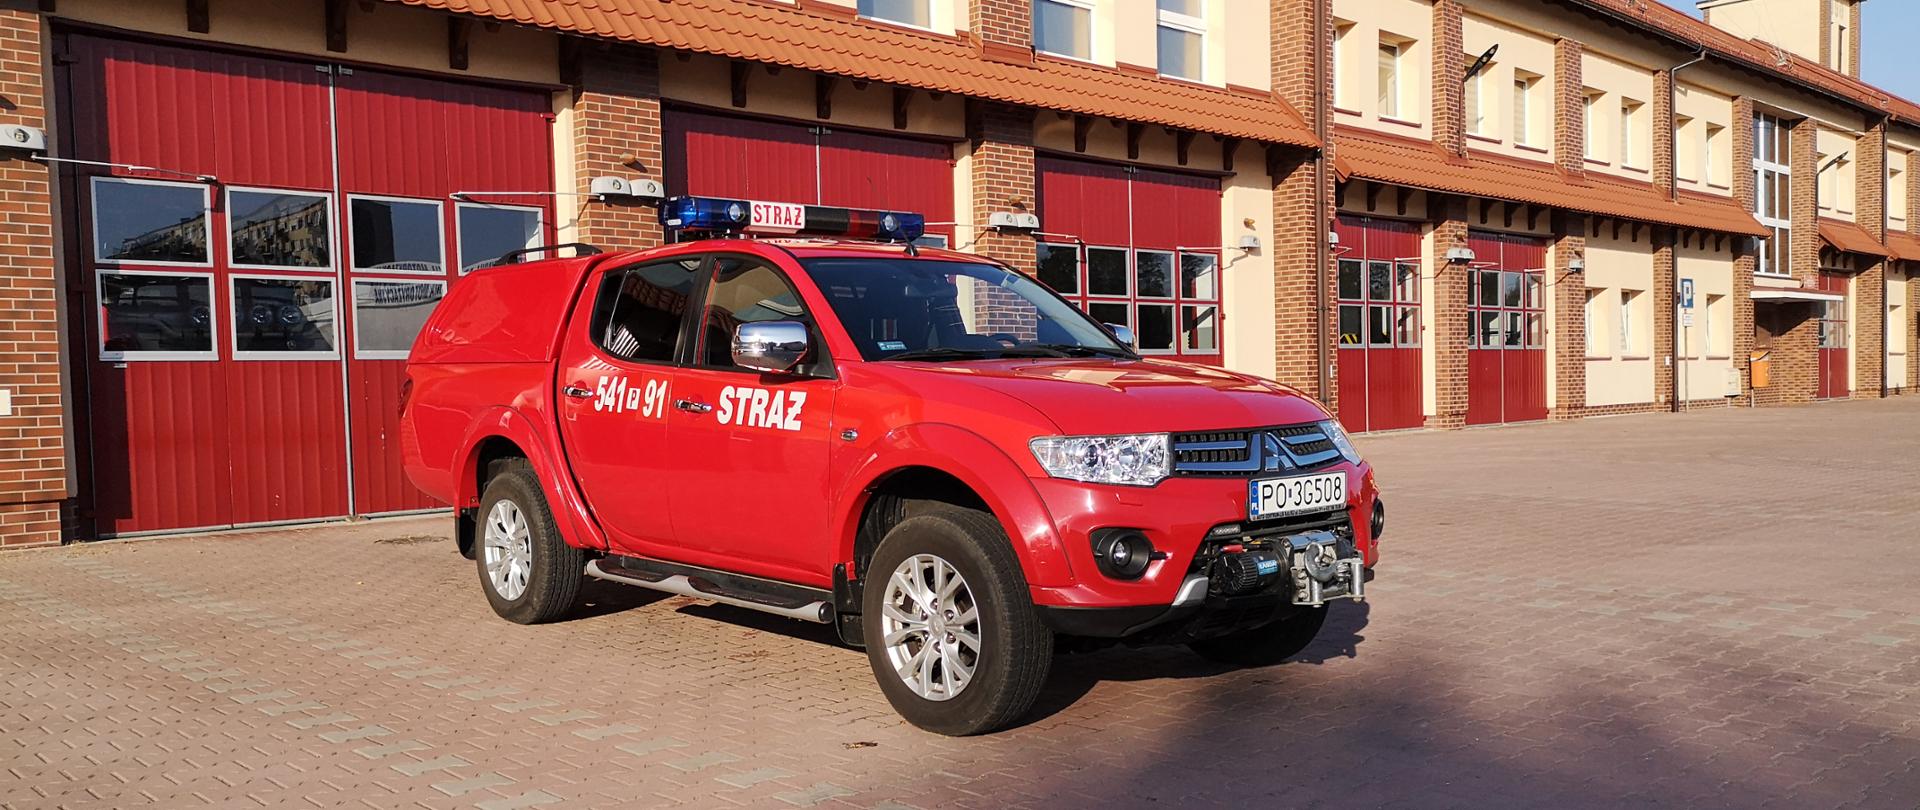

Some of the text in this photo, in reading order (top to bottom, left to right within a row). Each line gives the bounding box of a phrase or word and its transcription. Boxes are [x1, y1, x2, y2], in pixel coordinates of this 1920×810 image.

[1683, 281, 1692, 306] P
[594, 375, 628, 413] 541
[642, 378, 668, 419] 91
[1262, 476, 1342, 511] PO 3G508
